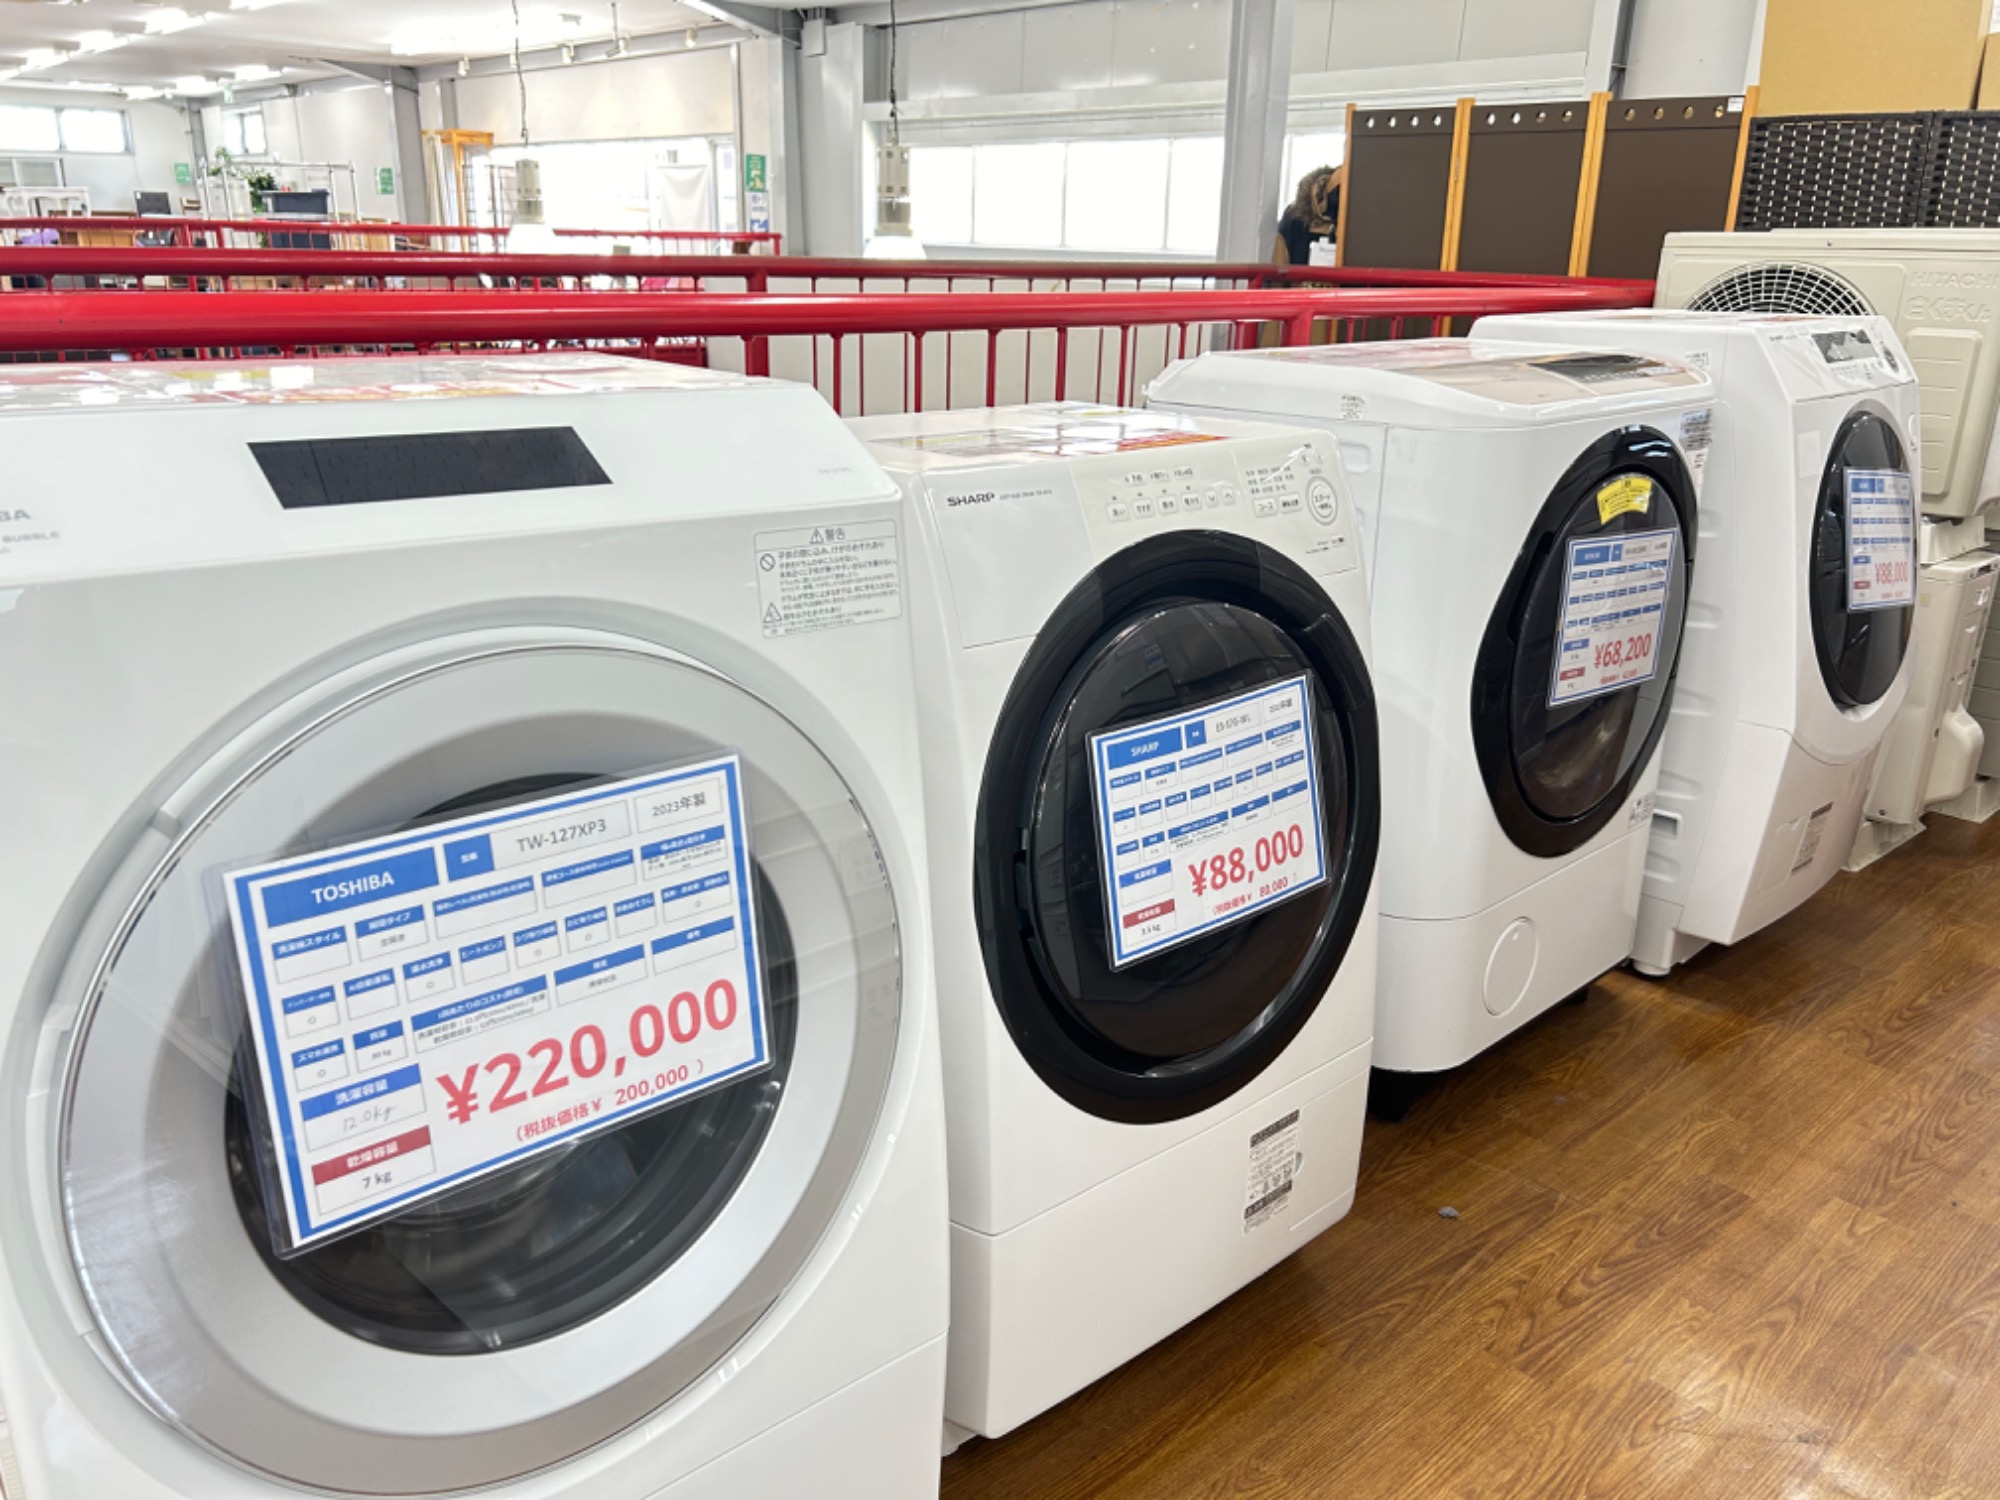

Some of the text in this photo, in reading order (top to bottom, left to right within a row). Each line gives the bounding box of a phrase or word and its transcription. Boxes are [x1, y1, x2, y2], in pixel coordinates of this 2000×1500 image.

[1910, 271, 1999, 289] HITACHI
[946, 491, 995, 507] SHARP
[2, 531, 60, 543] BUBBLE
[825, 527, 846, 541] 警告
[1594, 632, 1652, 669] ¥68,200
[1131, 741, 1160, 757] SHARP
[651, 792, 705, 816] 2023年製
[515, 819, 606, 852] TW-127XP3
[1189, 824, 1304, 897] ¥88,000
[311, 871, 395, 904] TOSHIBA
[1259, 876, 1289, 898] 80,000
[436, 978, 737, 1124] ¥220,000
[334, 1079, 387, 1104] 洗濯容量
[615, 1064, 688, 1106] 200,000
[346, 1142, 398, 1168] 乾燥容量
[362, 1169, 392, 1188] 7 kg
